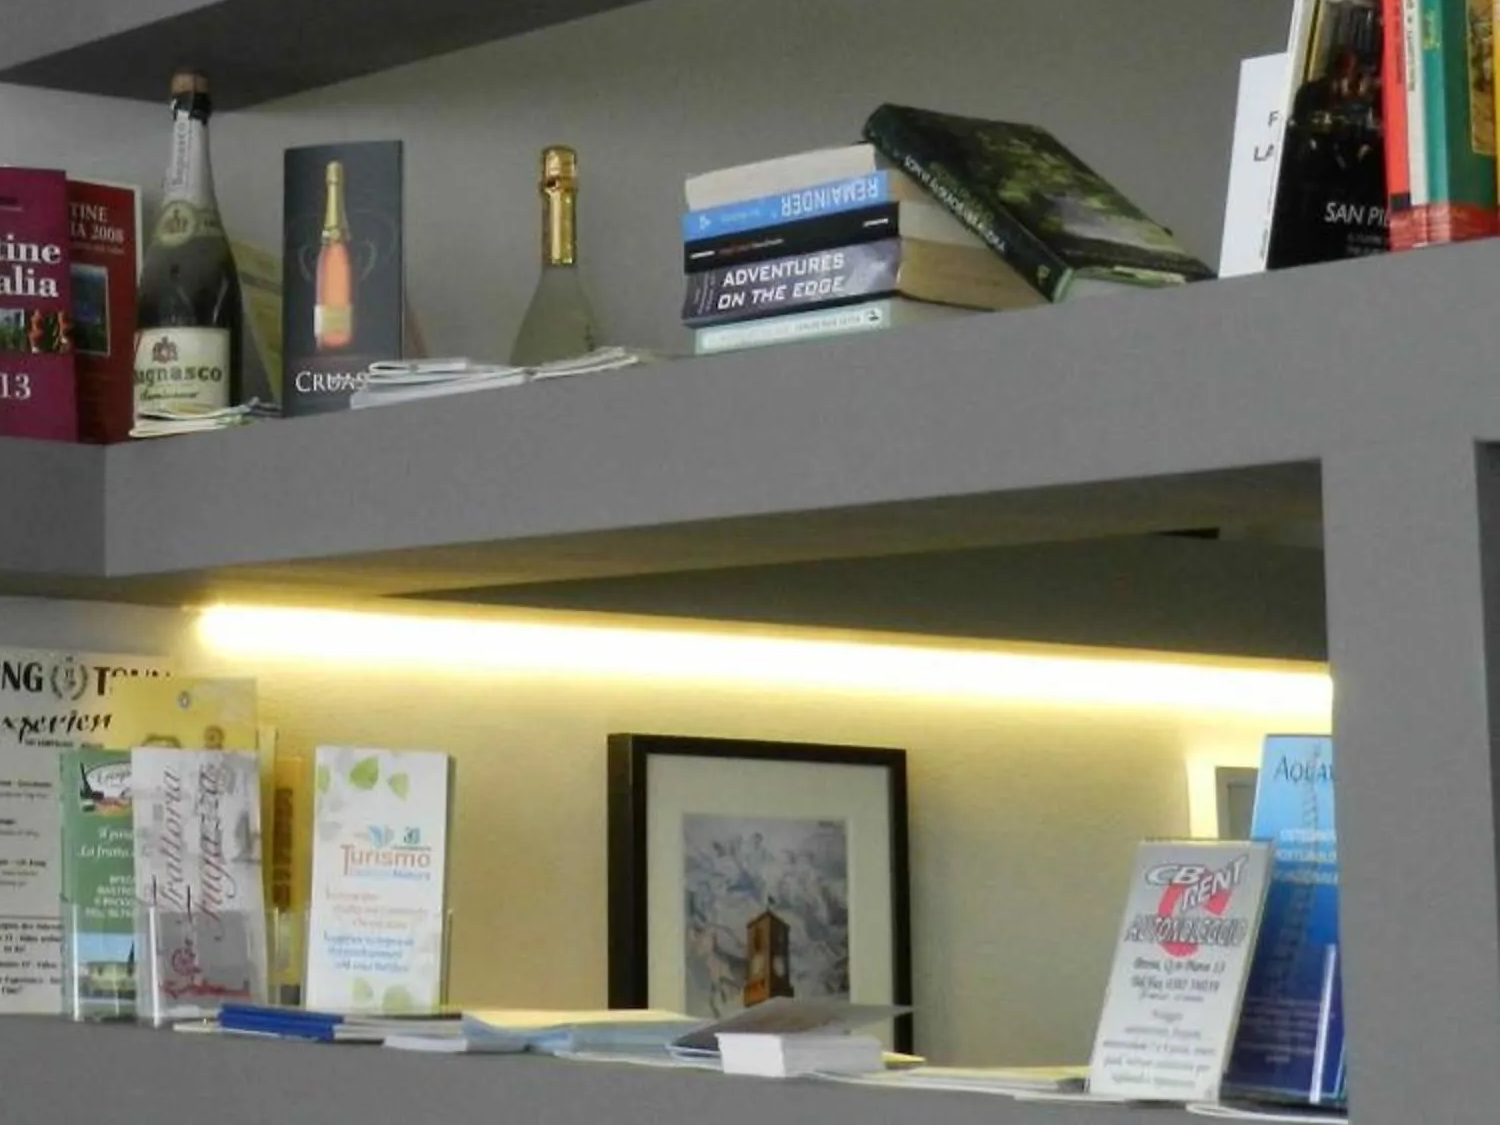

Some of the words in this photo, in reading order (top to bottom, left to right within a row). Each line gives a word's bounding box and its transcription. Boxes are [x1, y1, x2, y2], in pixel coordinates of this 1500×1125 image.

[780, 177, 880, 218] REMAINDER
[1323, 201, 1364, 225] SAN
[91, 225, 125, 243] 2008
[722, 252, 846, 288] ADVENTURES
[717, 291, 746, 311] ON
[751, 285, 787, 304] THE
[792, 275, 847, 299] EDGE
[340, 843, 431, 876] Turismo
[1145, 864, 1206, 887] CB
[1182, 853, 1249, 912] RENT
